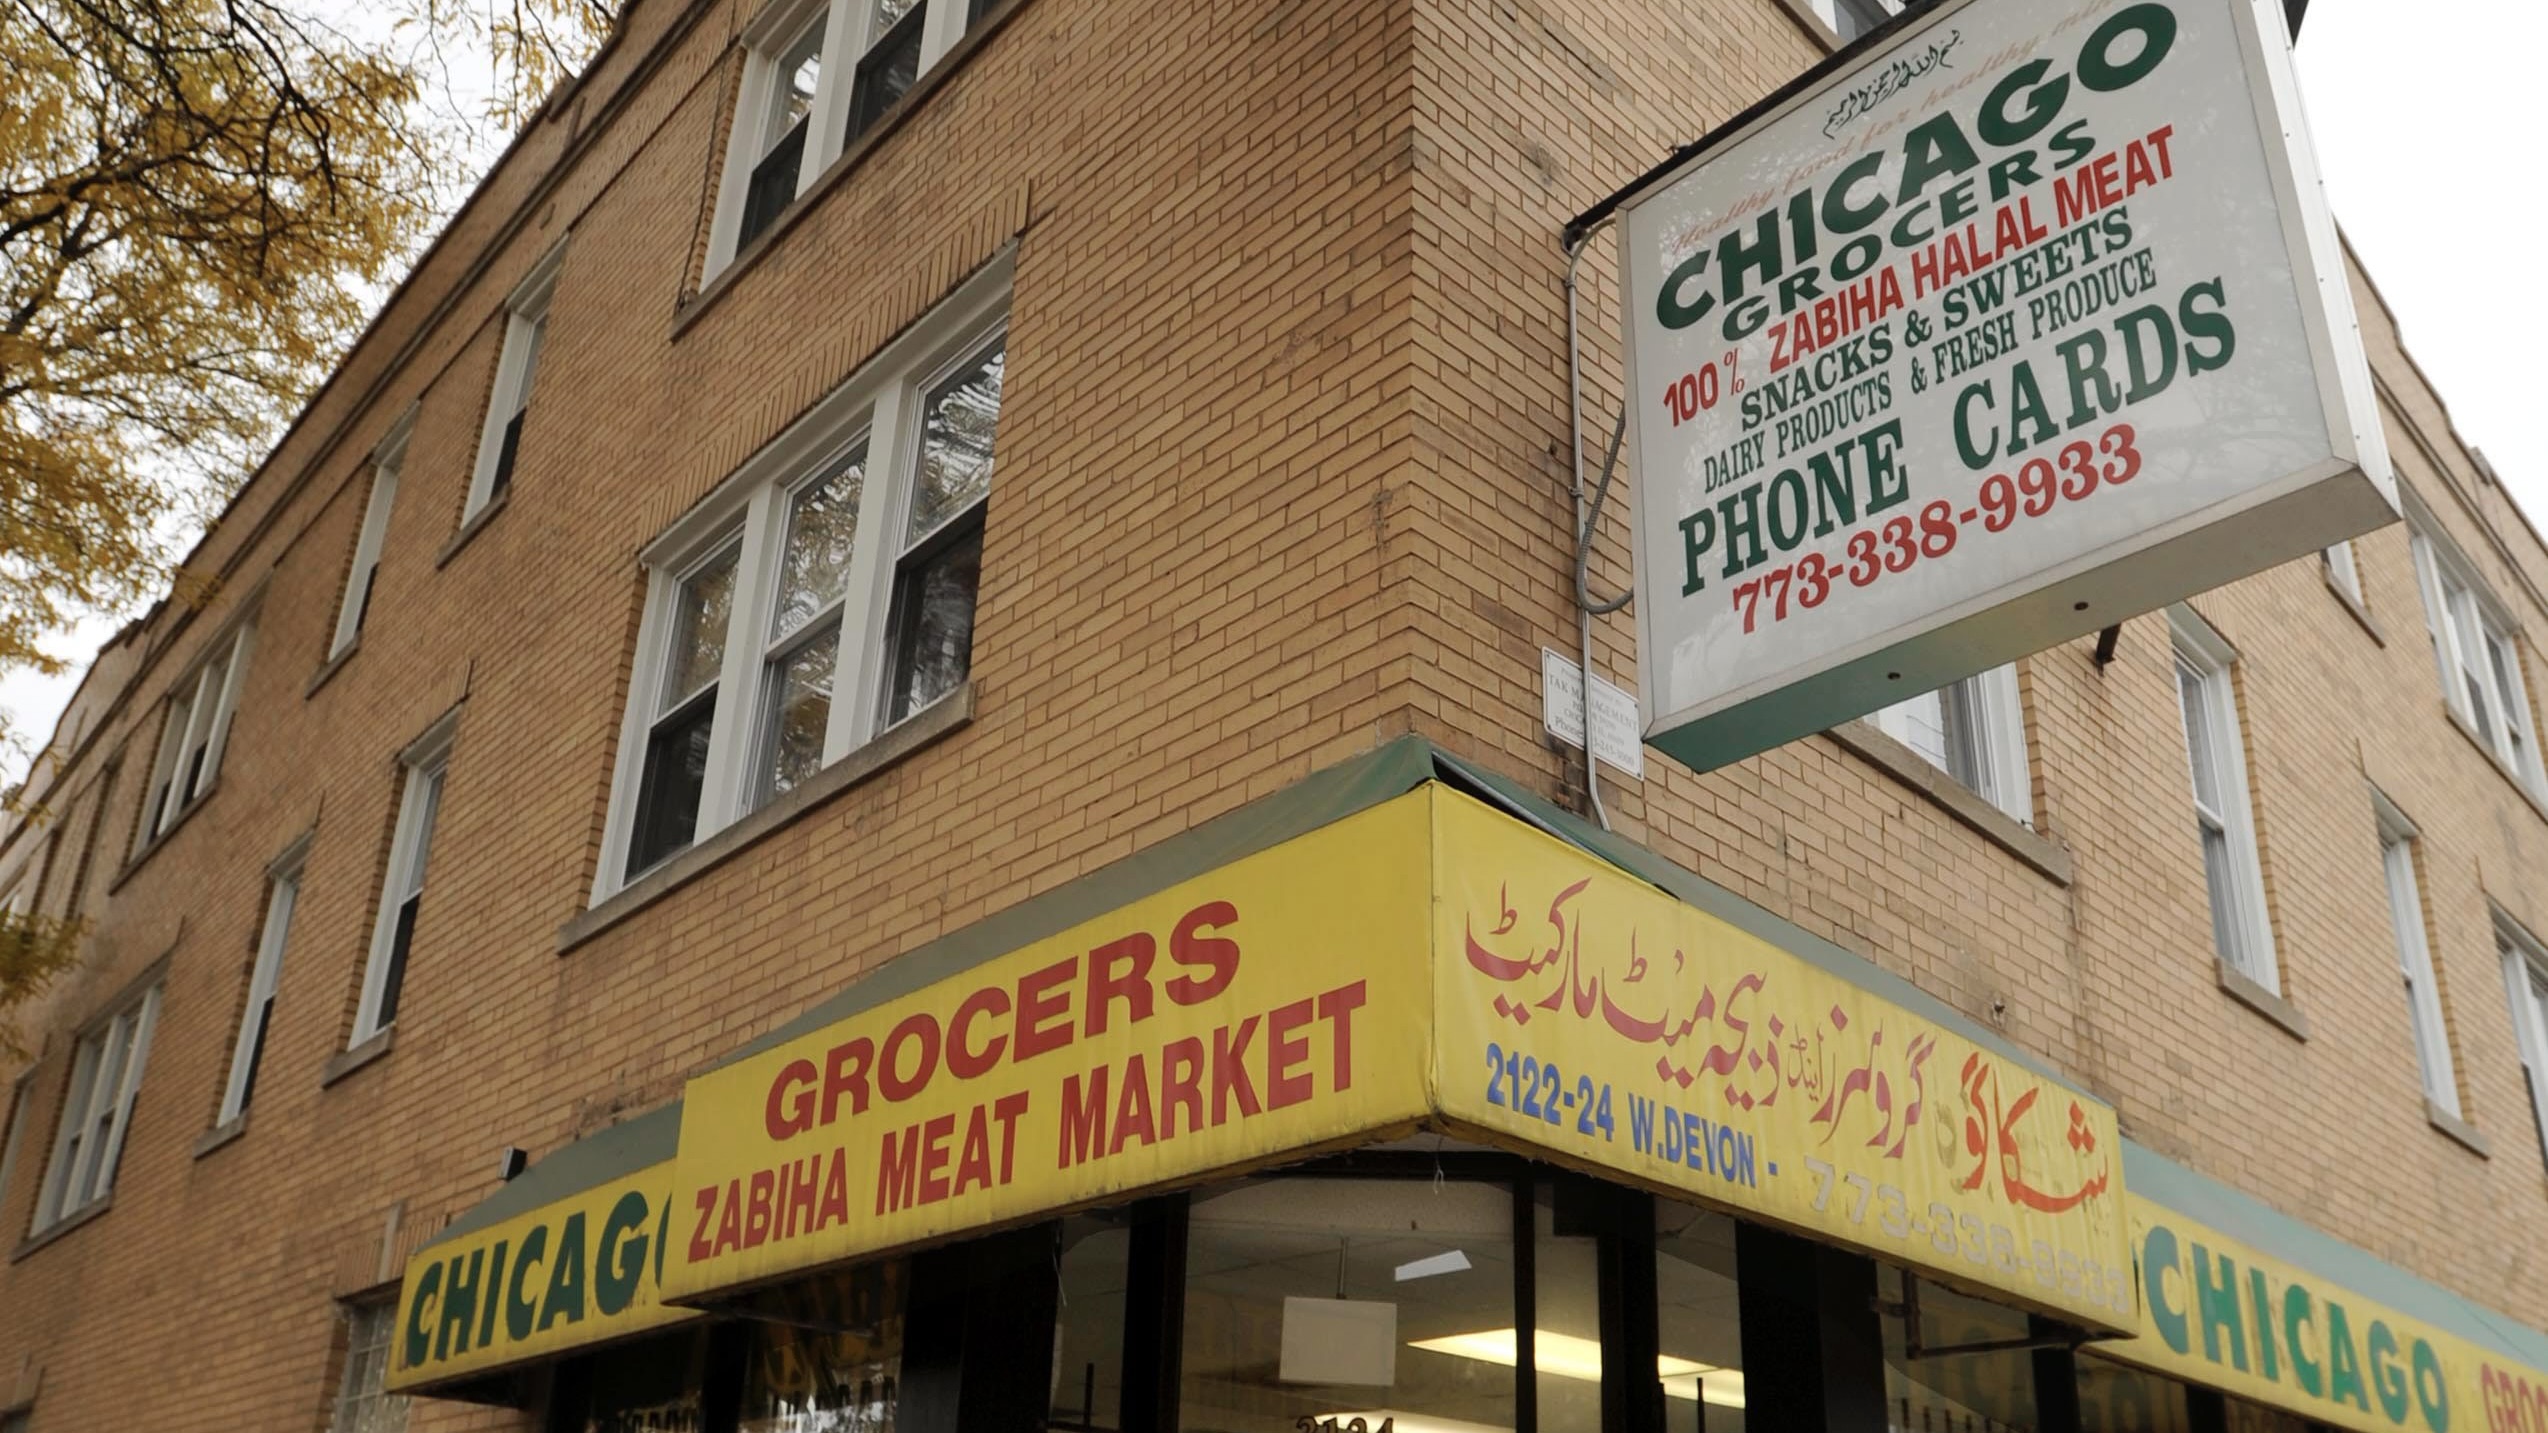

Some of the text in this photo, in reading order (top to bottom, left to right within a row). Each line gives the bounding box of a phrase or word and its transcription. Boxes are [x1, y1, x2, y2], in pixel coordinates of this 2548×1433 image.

[1655, 2, 2178, 331] CHICAGO
[1672, 187, 1778, 257] Healthy
[1860, 107, 1912, 157] for
[1919, 35, 2041, 114] healthy
[1721, 118, 2097, 343] GROCERS
[1768, 265, 1905, 374] ZABIHA
[1911, 200, 2048, 292] HALAL
[2055, 124, 2175, 220] MEAT
[1703, 247, 2158, 494] DAIRY PRODUCTS & FRESH PRODUCE
[1740, 205, 2133, 418] SNACKS & SWEETS
[1677, 277, 2237, 597] PHONE CARDS
[1732, 424, 2142, 634] 773-338-9933
[687, 980, 1367, 1264] ZABIHA MEAT MARKET
[765, 900, 1240, 1141] GROCERS
[1485, 1042, 1615, 1141] 2122-24
[2143, 1225, 2548, 1433] CHICAGO GRO
